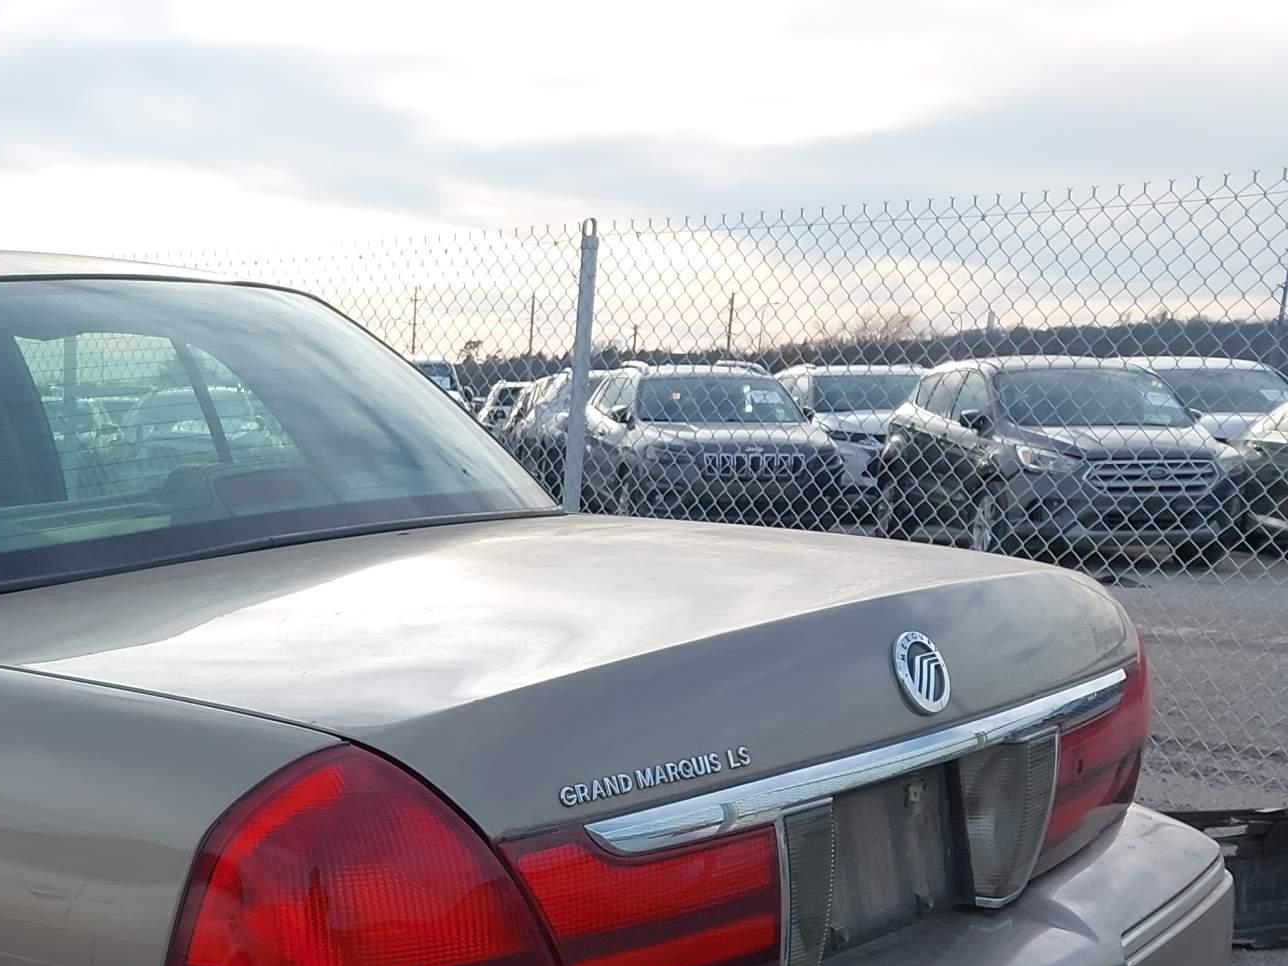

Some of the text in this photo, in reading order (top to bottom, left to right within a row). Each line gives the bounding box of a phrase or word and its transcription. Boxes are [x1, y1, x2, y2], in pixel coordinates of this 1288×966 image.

[560, 746, 752, 807] GRAND MARQUIS LS
